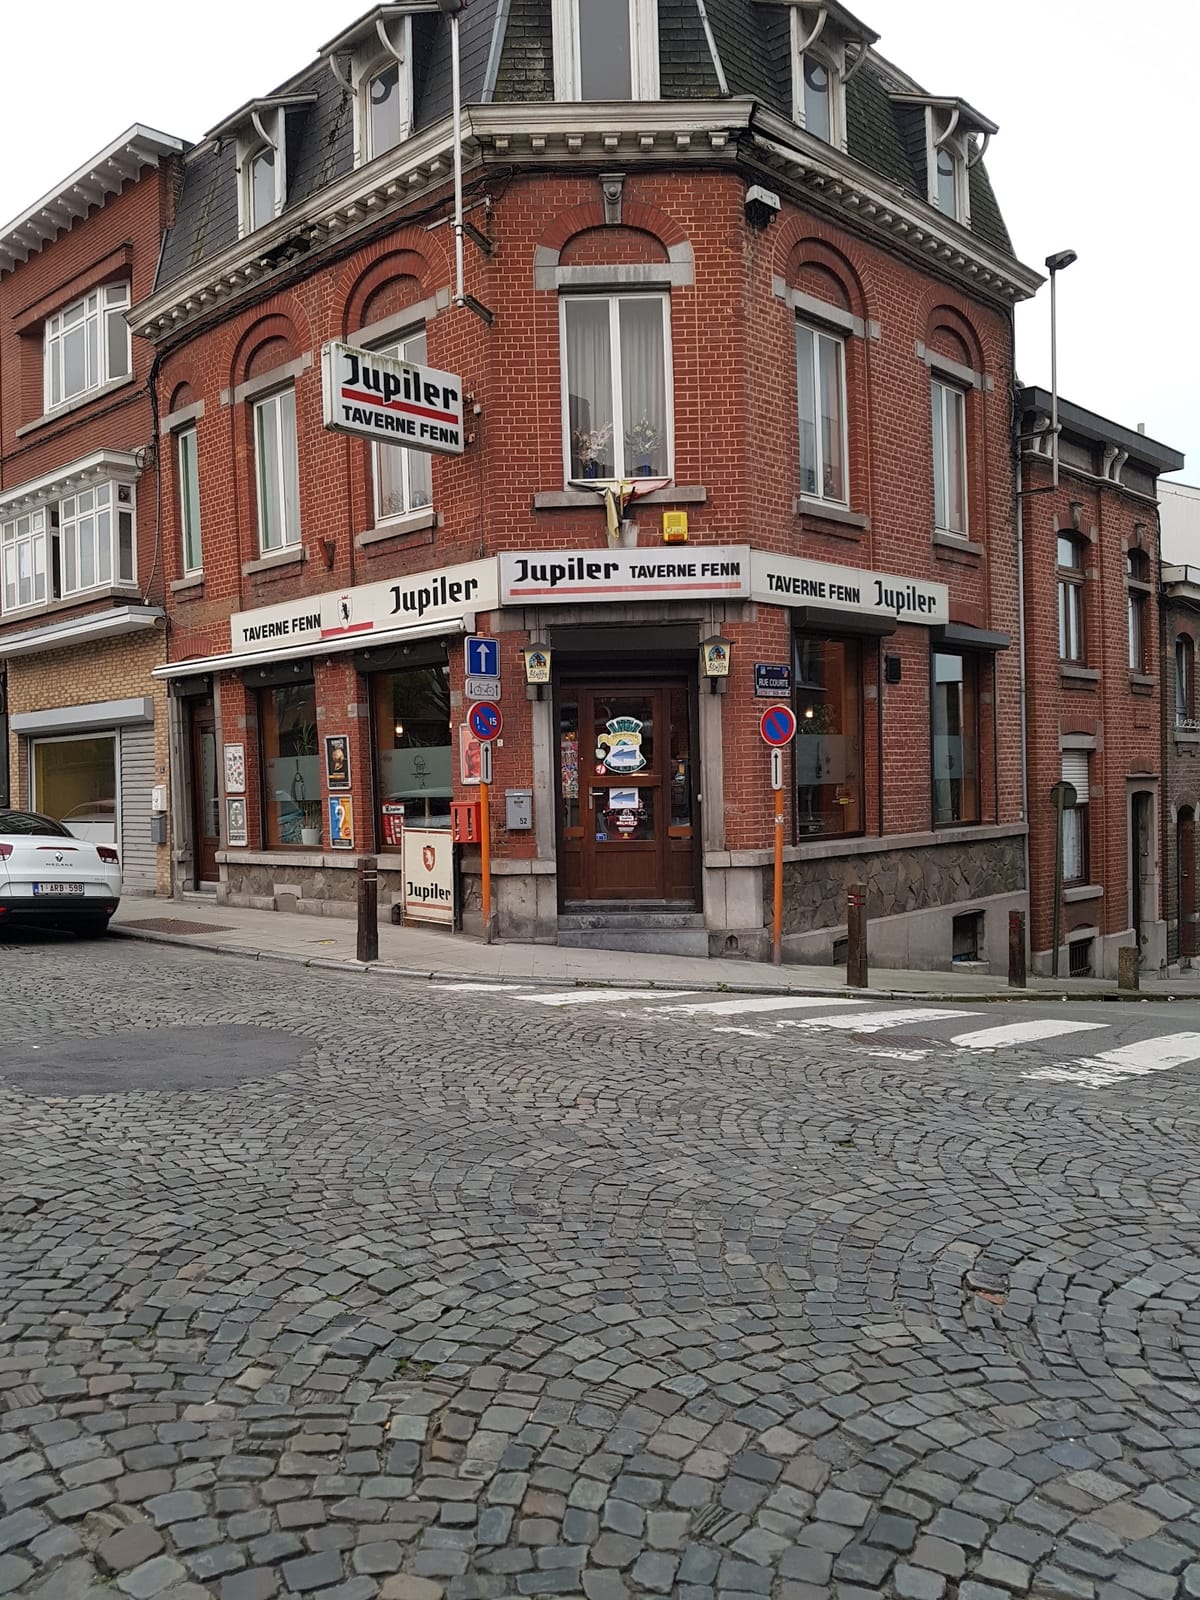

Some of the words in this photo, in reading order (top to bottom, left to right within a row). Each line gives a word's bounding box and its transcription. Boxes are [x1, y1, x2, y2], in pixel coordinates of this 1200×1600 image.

[342, 353, 458, 410] Jupiler
[342, 405, 416, 436] TAVERNE
[420, 423, 459, 446] FENN
[513, 557, 619, 587] Jupiler
[629, 564, 696, 579] TAVERNE
[701, 562, 741, 577] FENN
[243, 621, 290, 642] TAVERNE
[292, 613, 321, 633] FENN
[389, 576, 478, 617] Jupiler
[767, 573, 826, 599] TAVERNE
[829, 583, 860, 604] FENN
[874, 580, 936, 616] Jupiler
[758, 678, 769, 687] RUE
[489, 717, 497, 726] 15
[519, 817, 528, 825] 52
[407, 881, 451, 902] Jupiler
